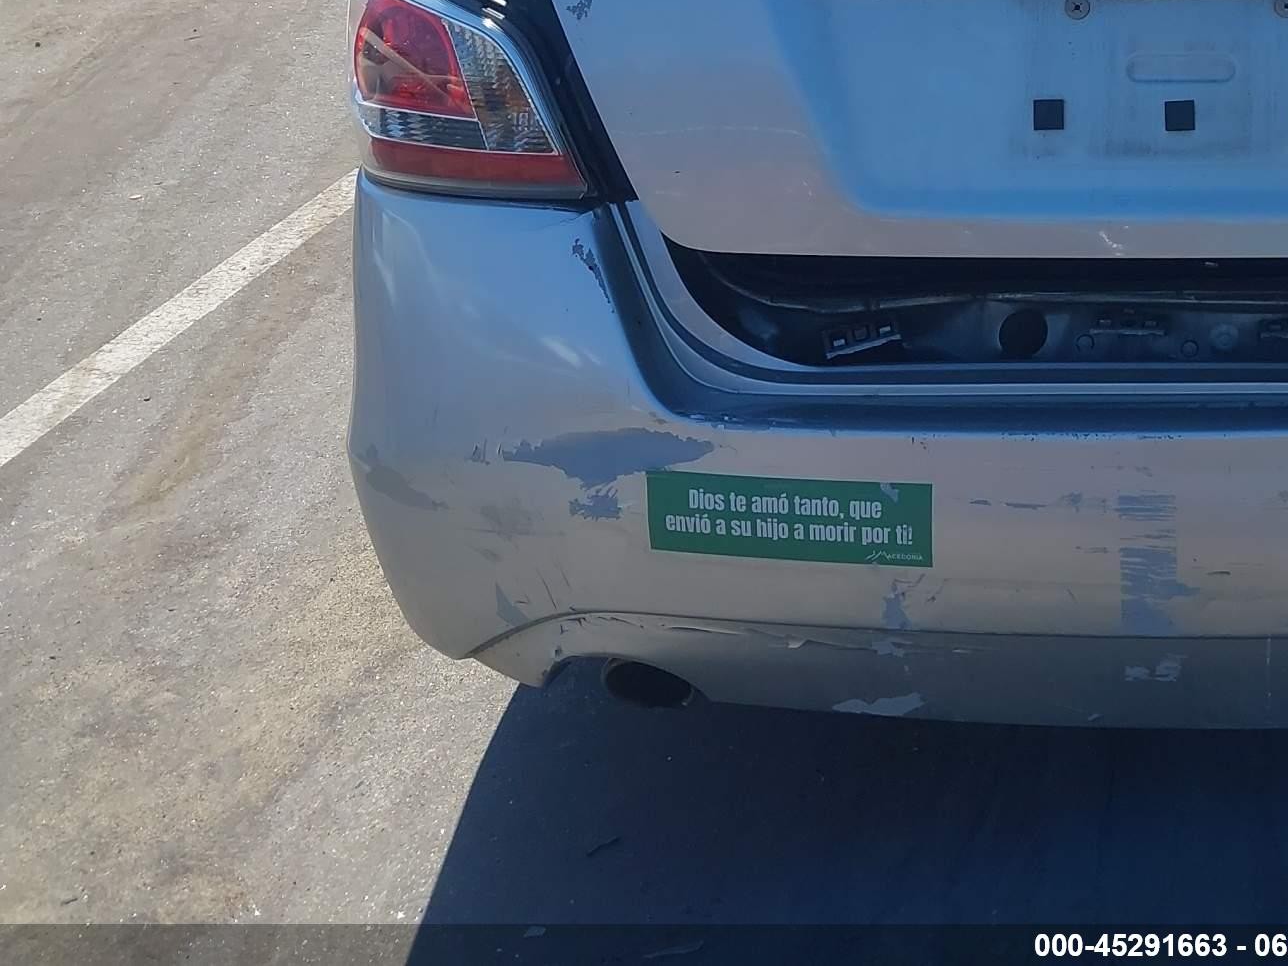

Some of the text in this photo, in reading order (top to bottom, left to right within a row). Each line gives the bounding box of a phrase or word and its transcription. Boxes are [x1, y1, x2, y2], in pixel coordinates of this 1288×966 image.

[688, 488, 882, 520] Dios te amó tanto, que
[665, 513, 712, 534] envió
[715, 518, 726, 535] a
[731, 519, 752, 537] su
[756, 518, 789, 540] hijo
[793, 523, 805, 540] a
[809, 521, 857, 542] morir
[861, 526, 891, 545] por
